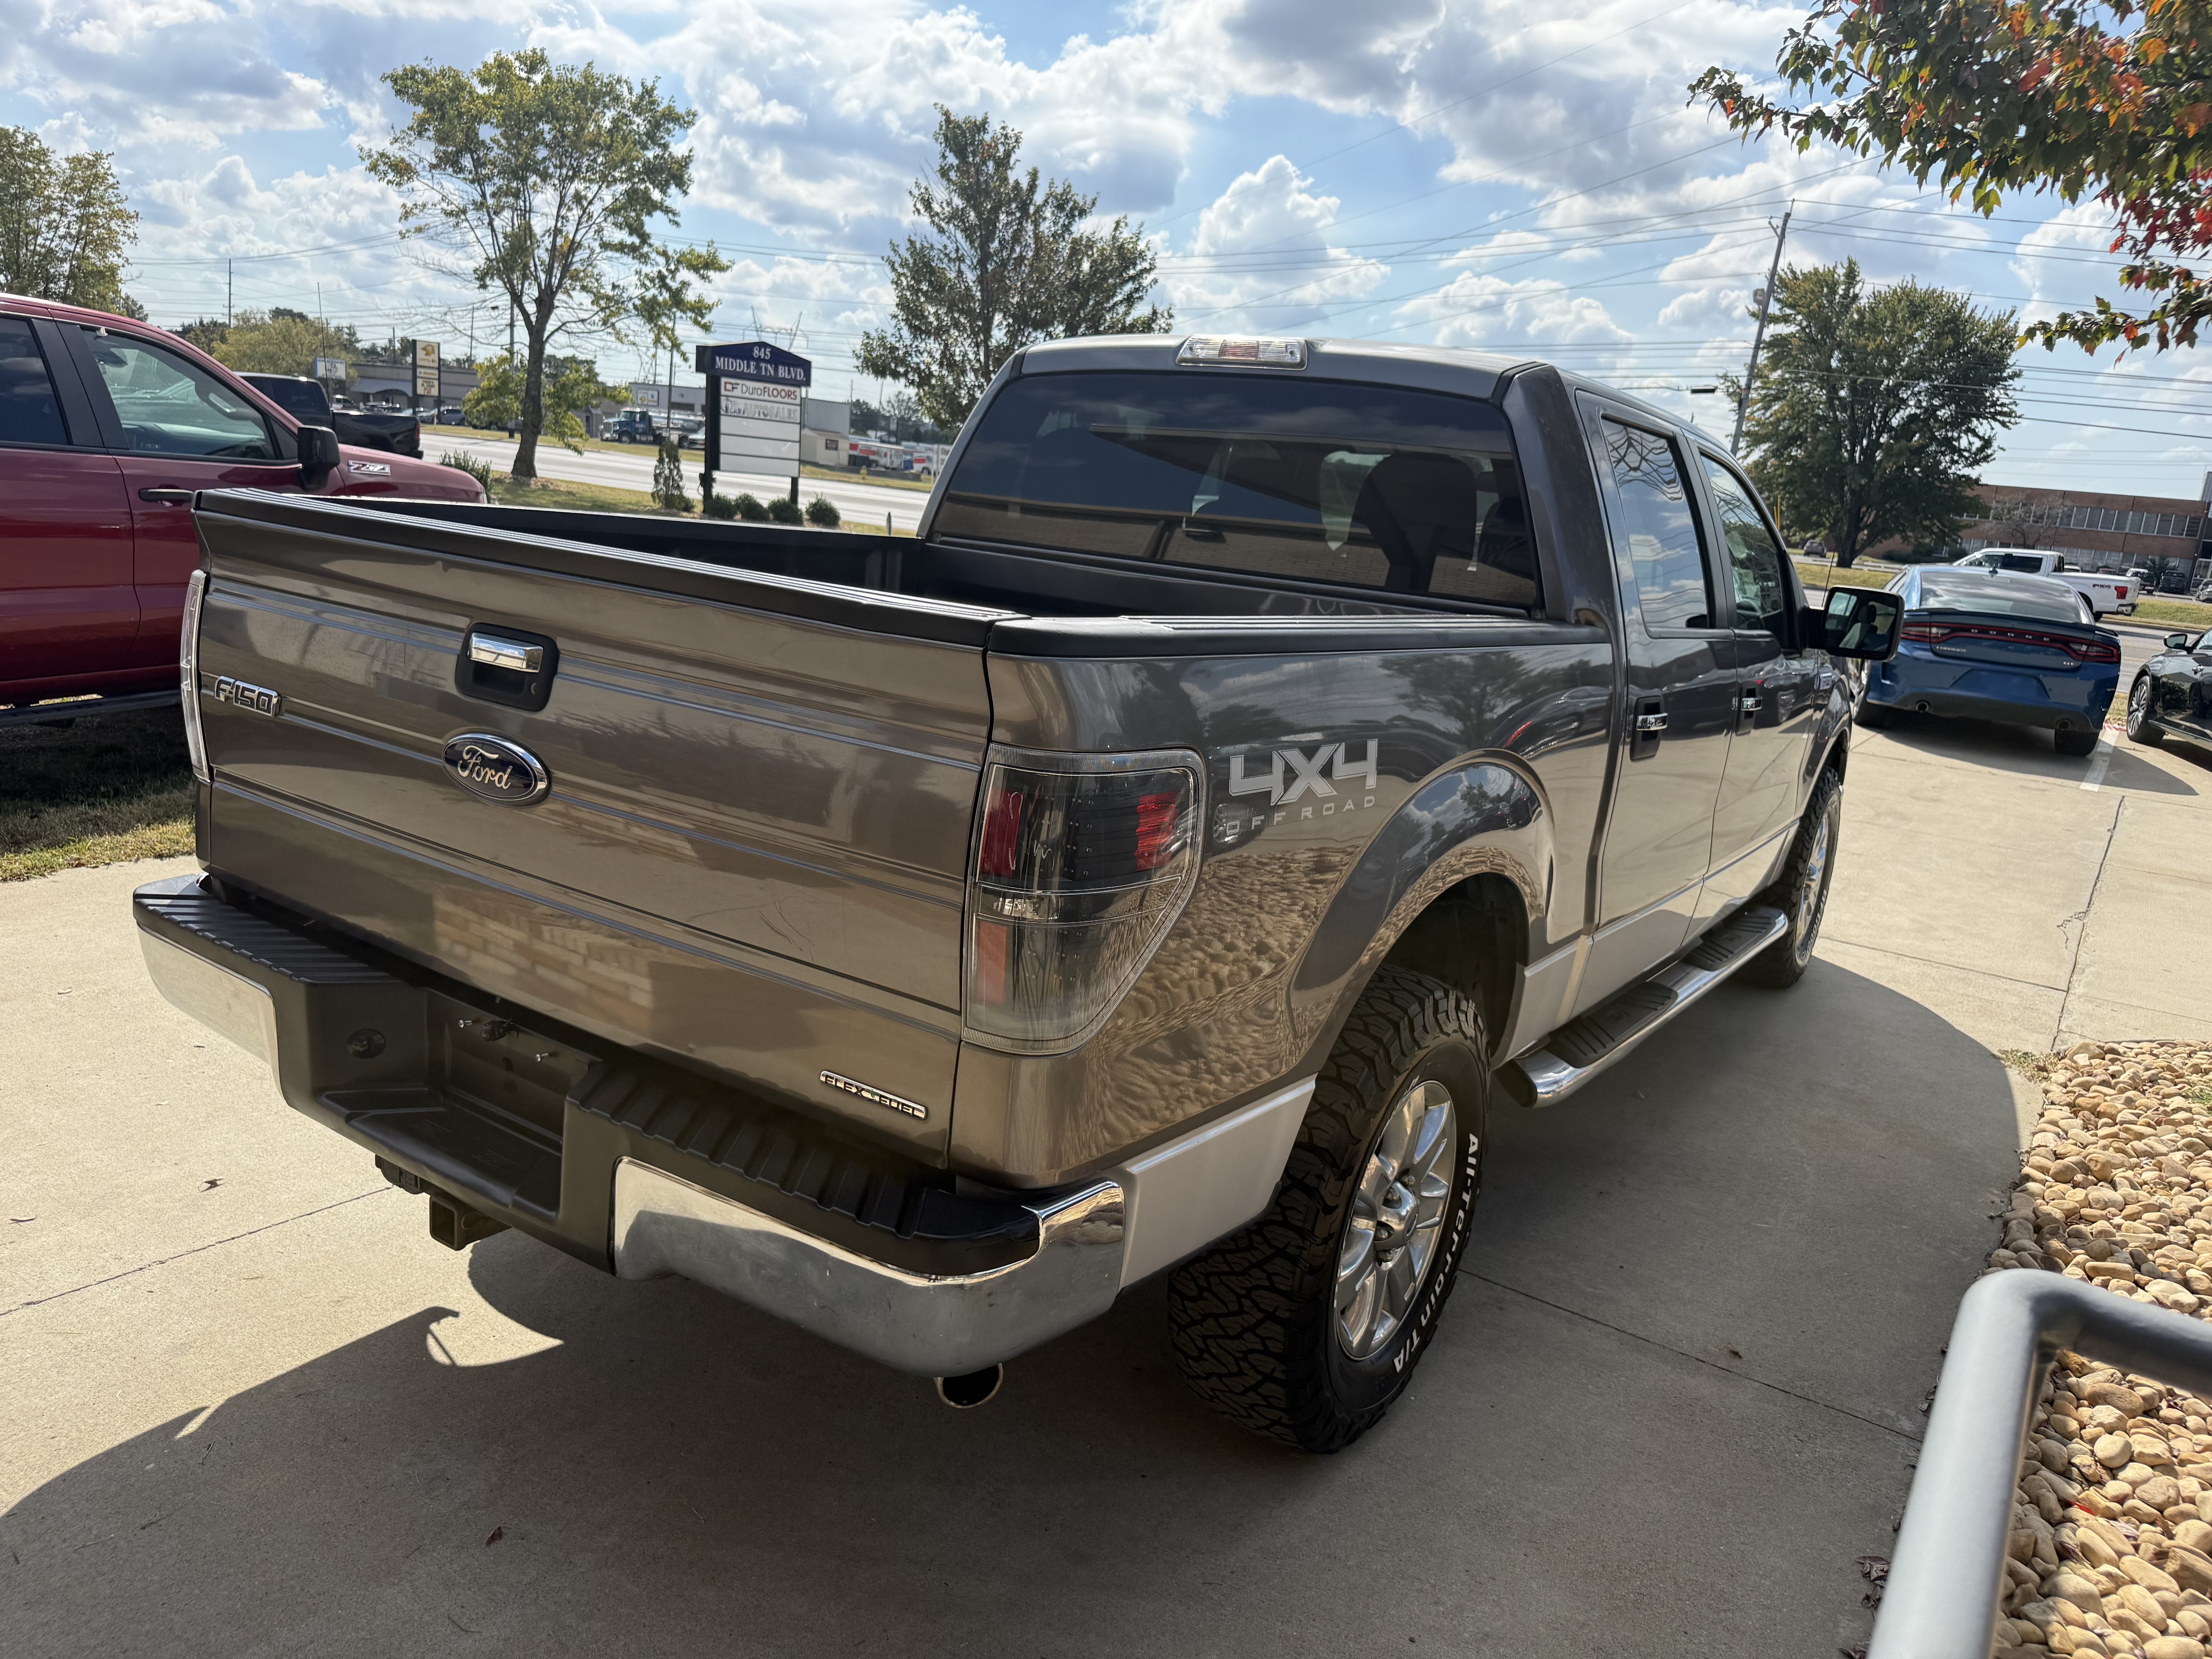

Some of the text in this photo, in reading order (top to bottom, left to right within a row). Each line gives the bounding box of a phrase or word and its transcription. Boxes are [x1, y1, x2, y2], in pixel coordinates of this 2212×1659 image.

[752, 346, 771, 360] 845
[715, 356, 806, 381] MIDDLE TN BLVD.
[741, 384, 797, 400] DuraFLOORS
[457, 745, 513, 789] Ford
[1226, 796, 1375, 835] OFF ROAD
[824, 1074, 865, 1098] FLEX
[1393, 1329, 1420, 1373] T/A
